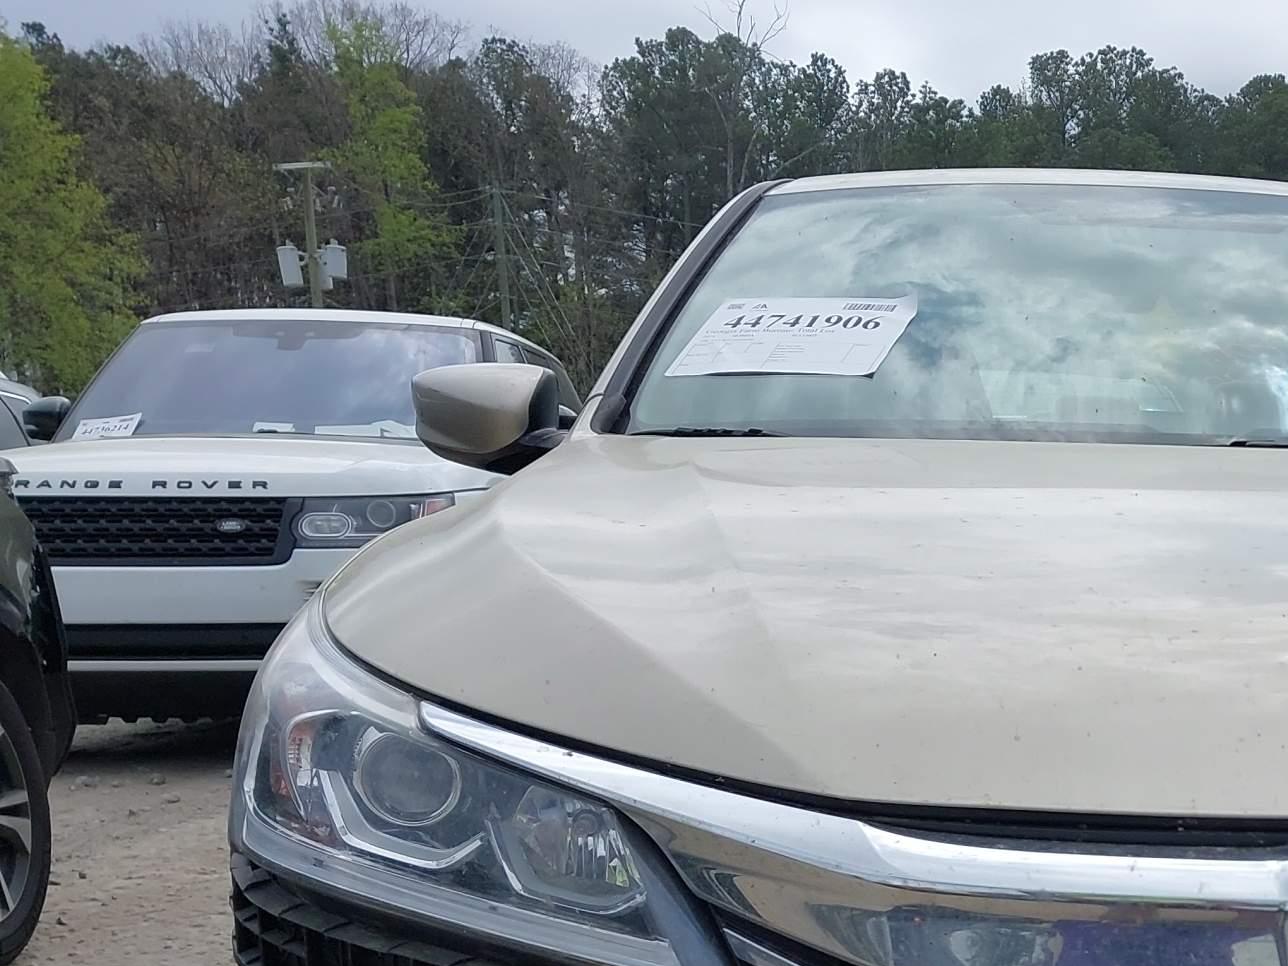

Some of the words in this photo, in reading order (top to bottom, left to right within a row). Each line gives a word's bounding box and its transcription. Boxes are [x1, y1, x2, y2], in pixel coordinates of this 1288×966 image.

[724, 314, 881, 331] 44741906
[14, 480, 123, 489] RANGE
[152, 480, 268, 489] ROVER
